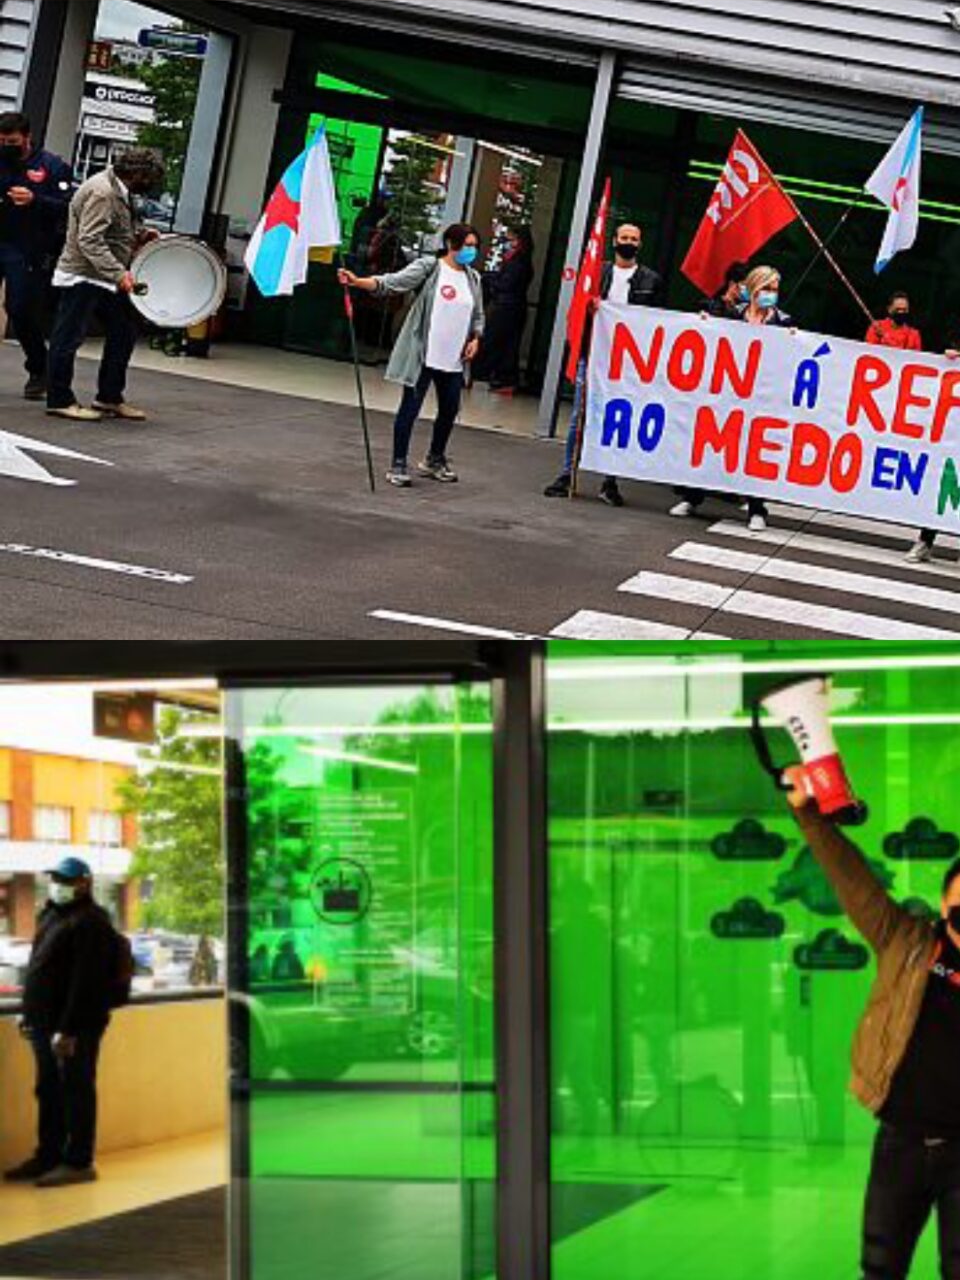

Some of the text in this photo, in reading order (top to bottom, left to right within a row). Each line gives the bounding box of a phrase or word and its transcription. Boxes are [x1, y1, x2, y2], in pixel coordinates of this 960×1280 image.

[608, 322, 762, 399] NON
[600, 398, 666, 453] AO
[690, 406, 864, 493] MEDO
[870, 446, 929, 495] EN
